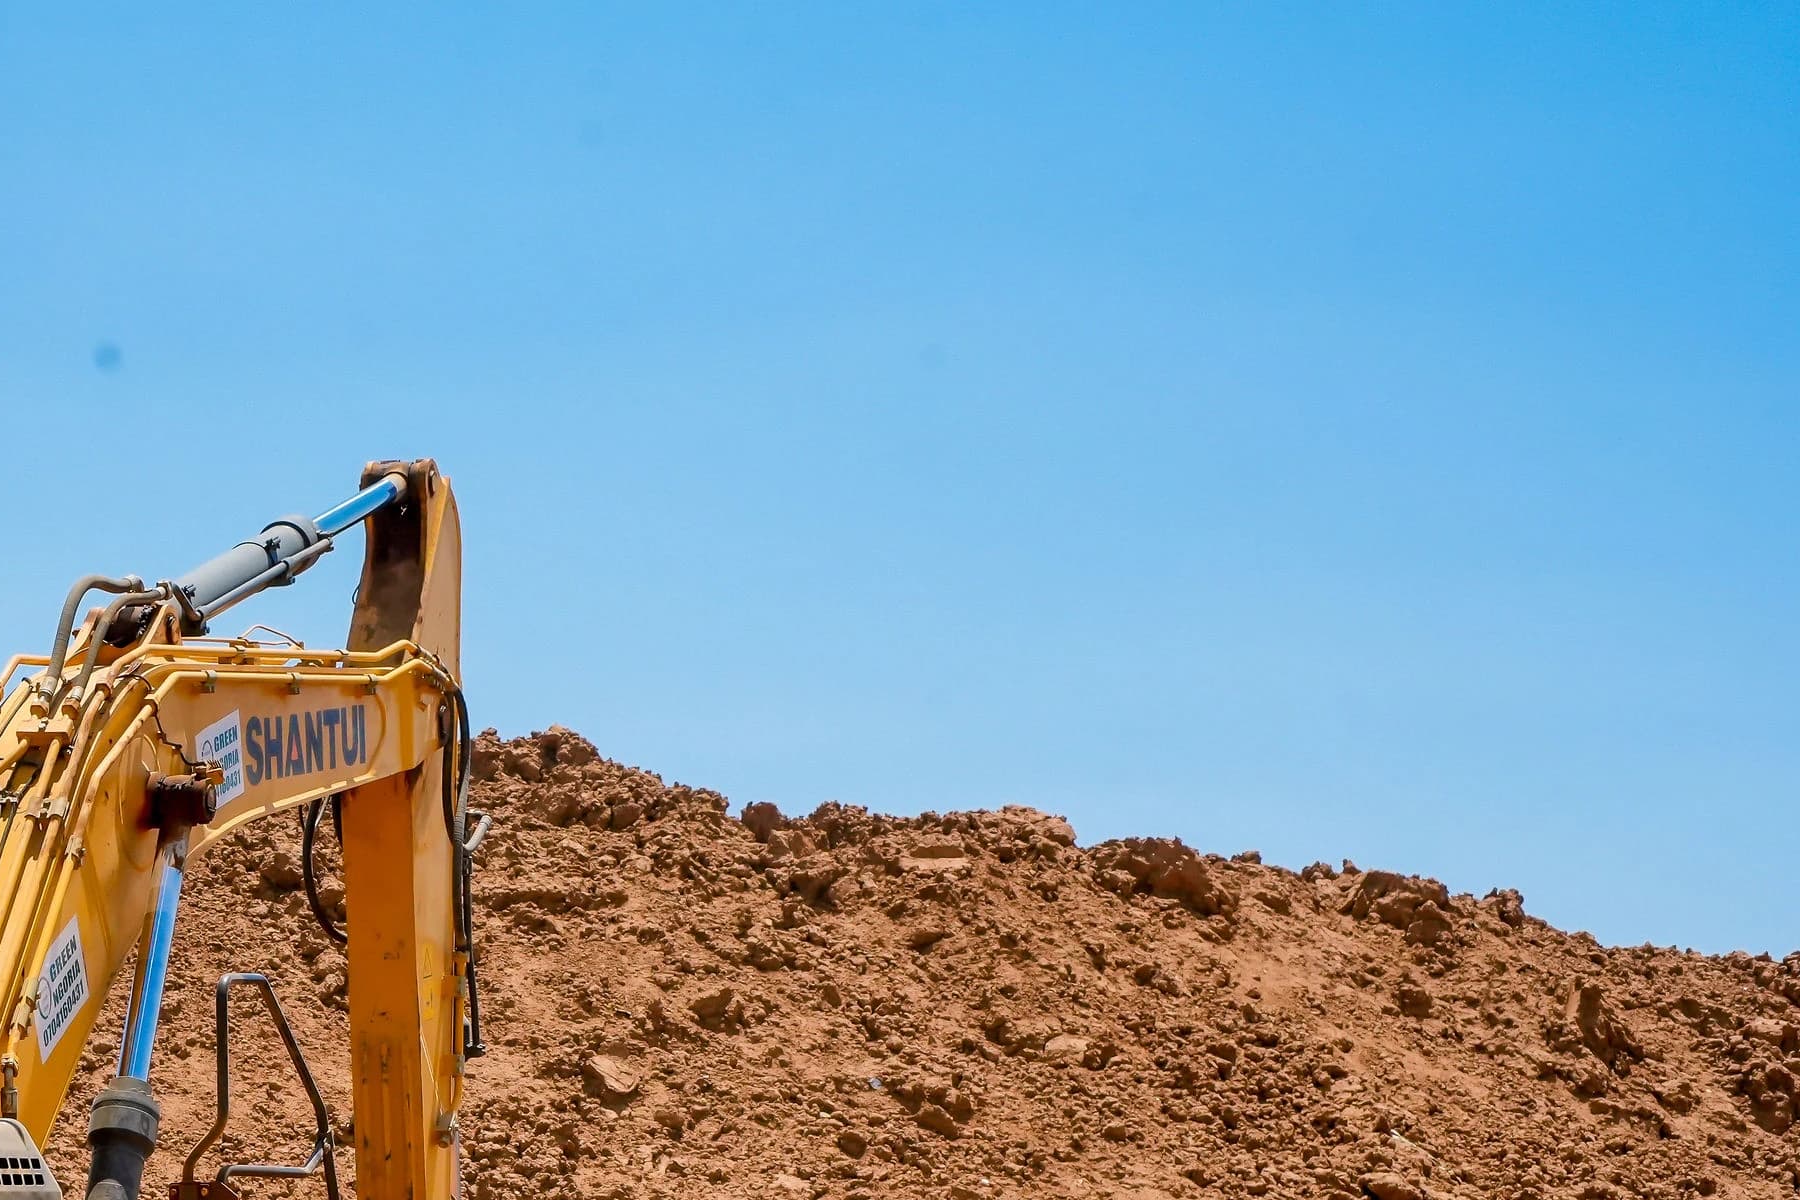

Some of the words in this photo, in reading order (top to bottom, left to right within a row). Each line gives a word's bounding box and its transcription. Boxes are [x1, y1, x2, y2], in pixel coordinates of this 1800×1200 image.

[214, 725, 238, 752] GREEN
[220, 748, 239, 771] GORIA
[246, 704, 366, 785] SHANTUI
[50, 934, 77, 982] GREEN
[52, 959, 81, 1008] NGORIA
[43, 979, 85, 1047] 0704160431
